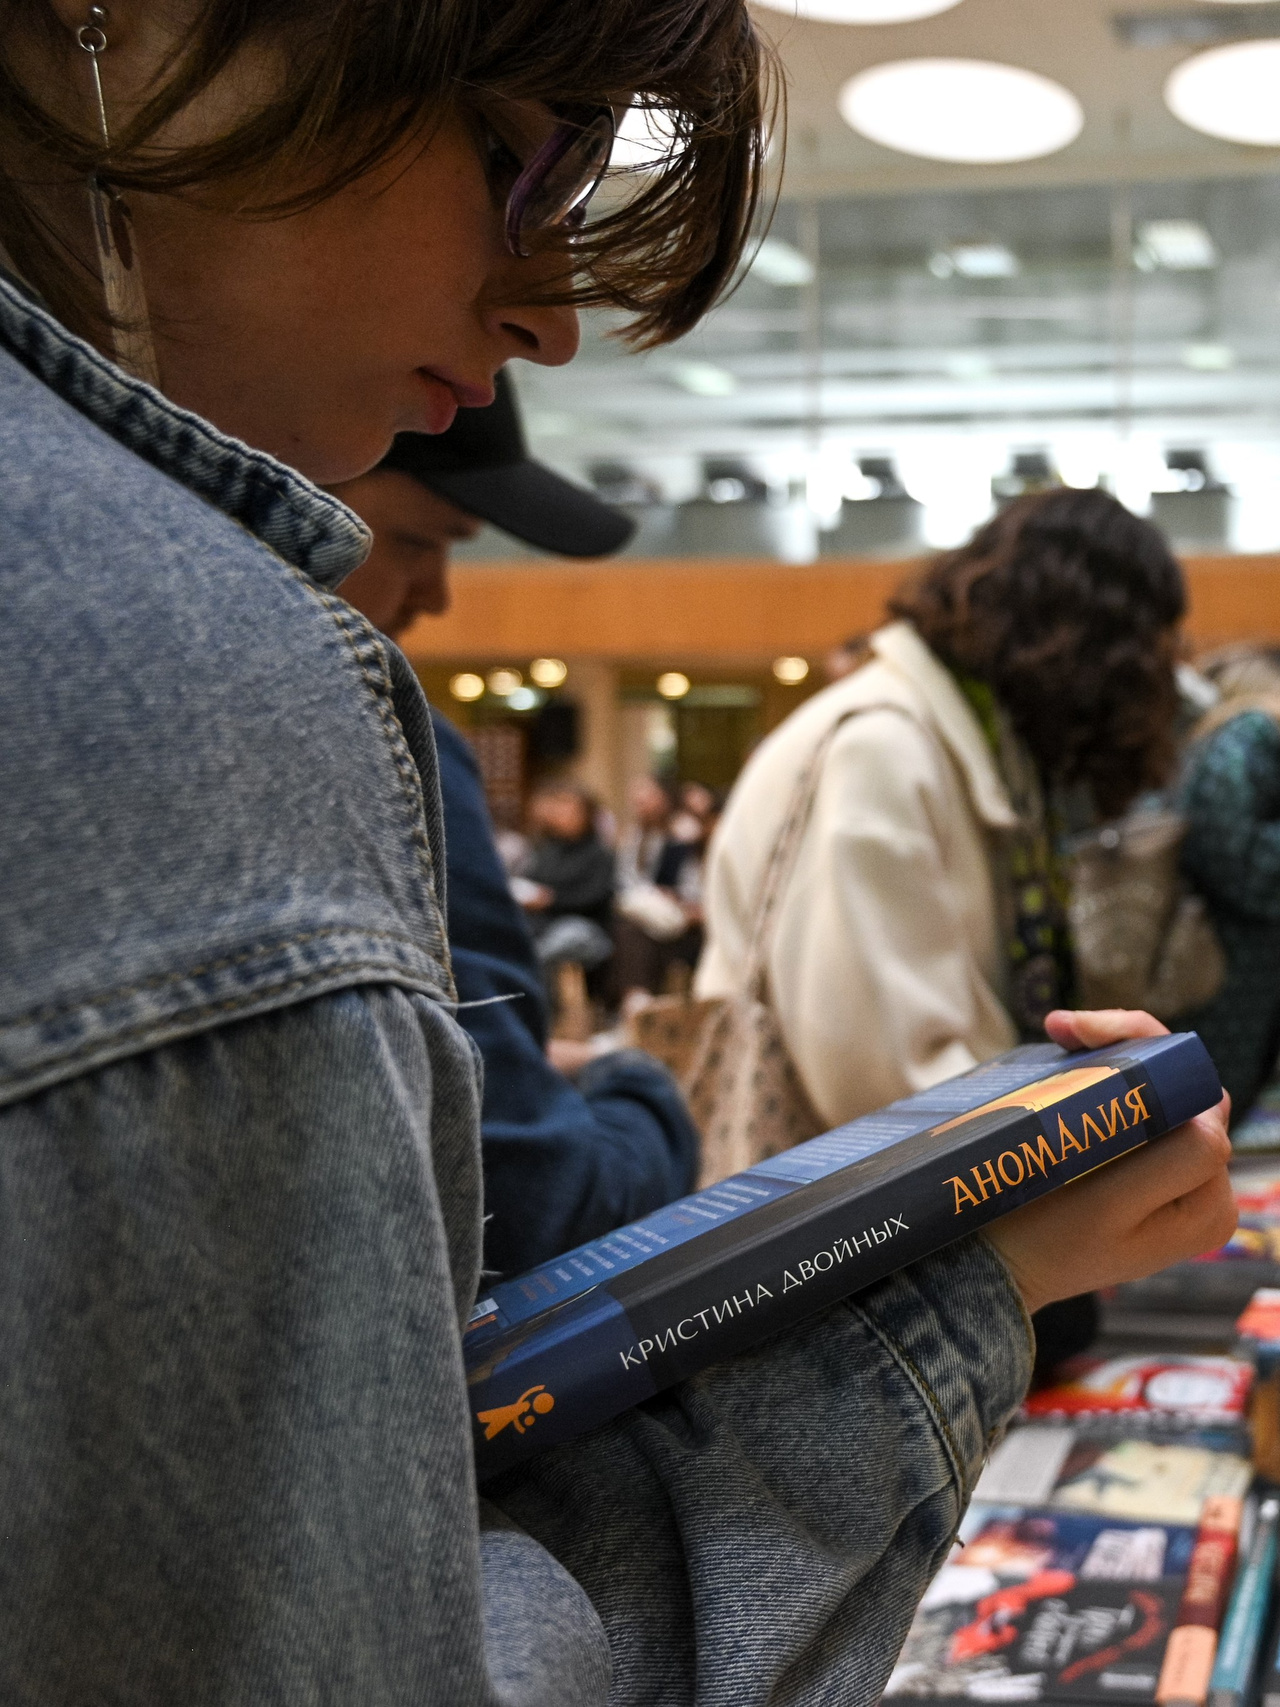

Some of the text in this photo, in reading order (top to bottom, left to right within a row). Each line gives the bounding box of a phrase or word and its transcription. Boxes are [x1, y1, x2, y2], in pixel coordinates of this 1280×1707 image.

[941, 1082, 1152, 1215] АНОМАЛИЯ
[619, 1212, 910, 1370] КРИСТИНА ДВОЙНЫХ
